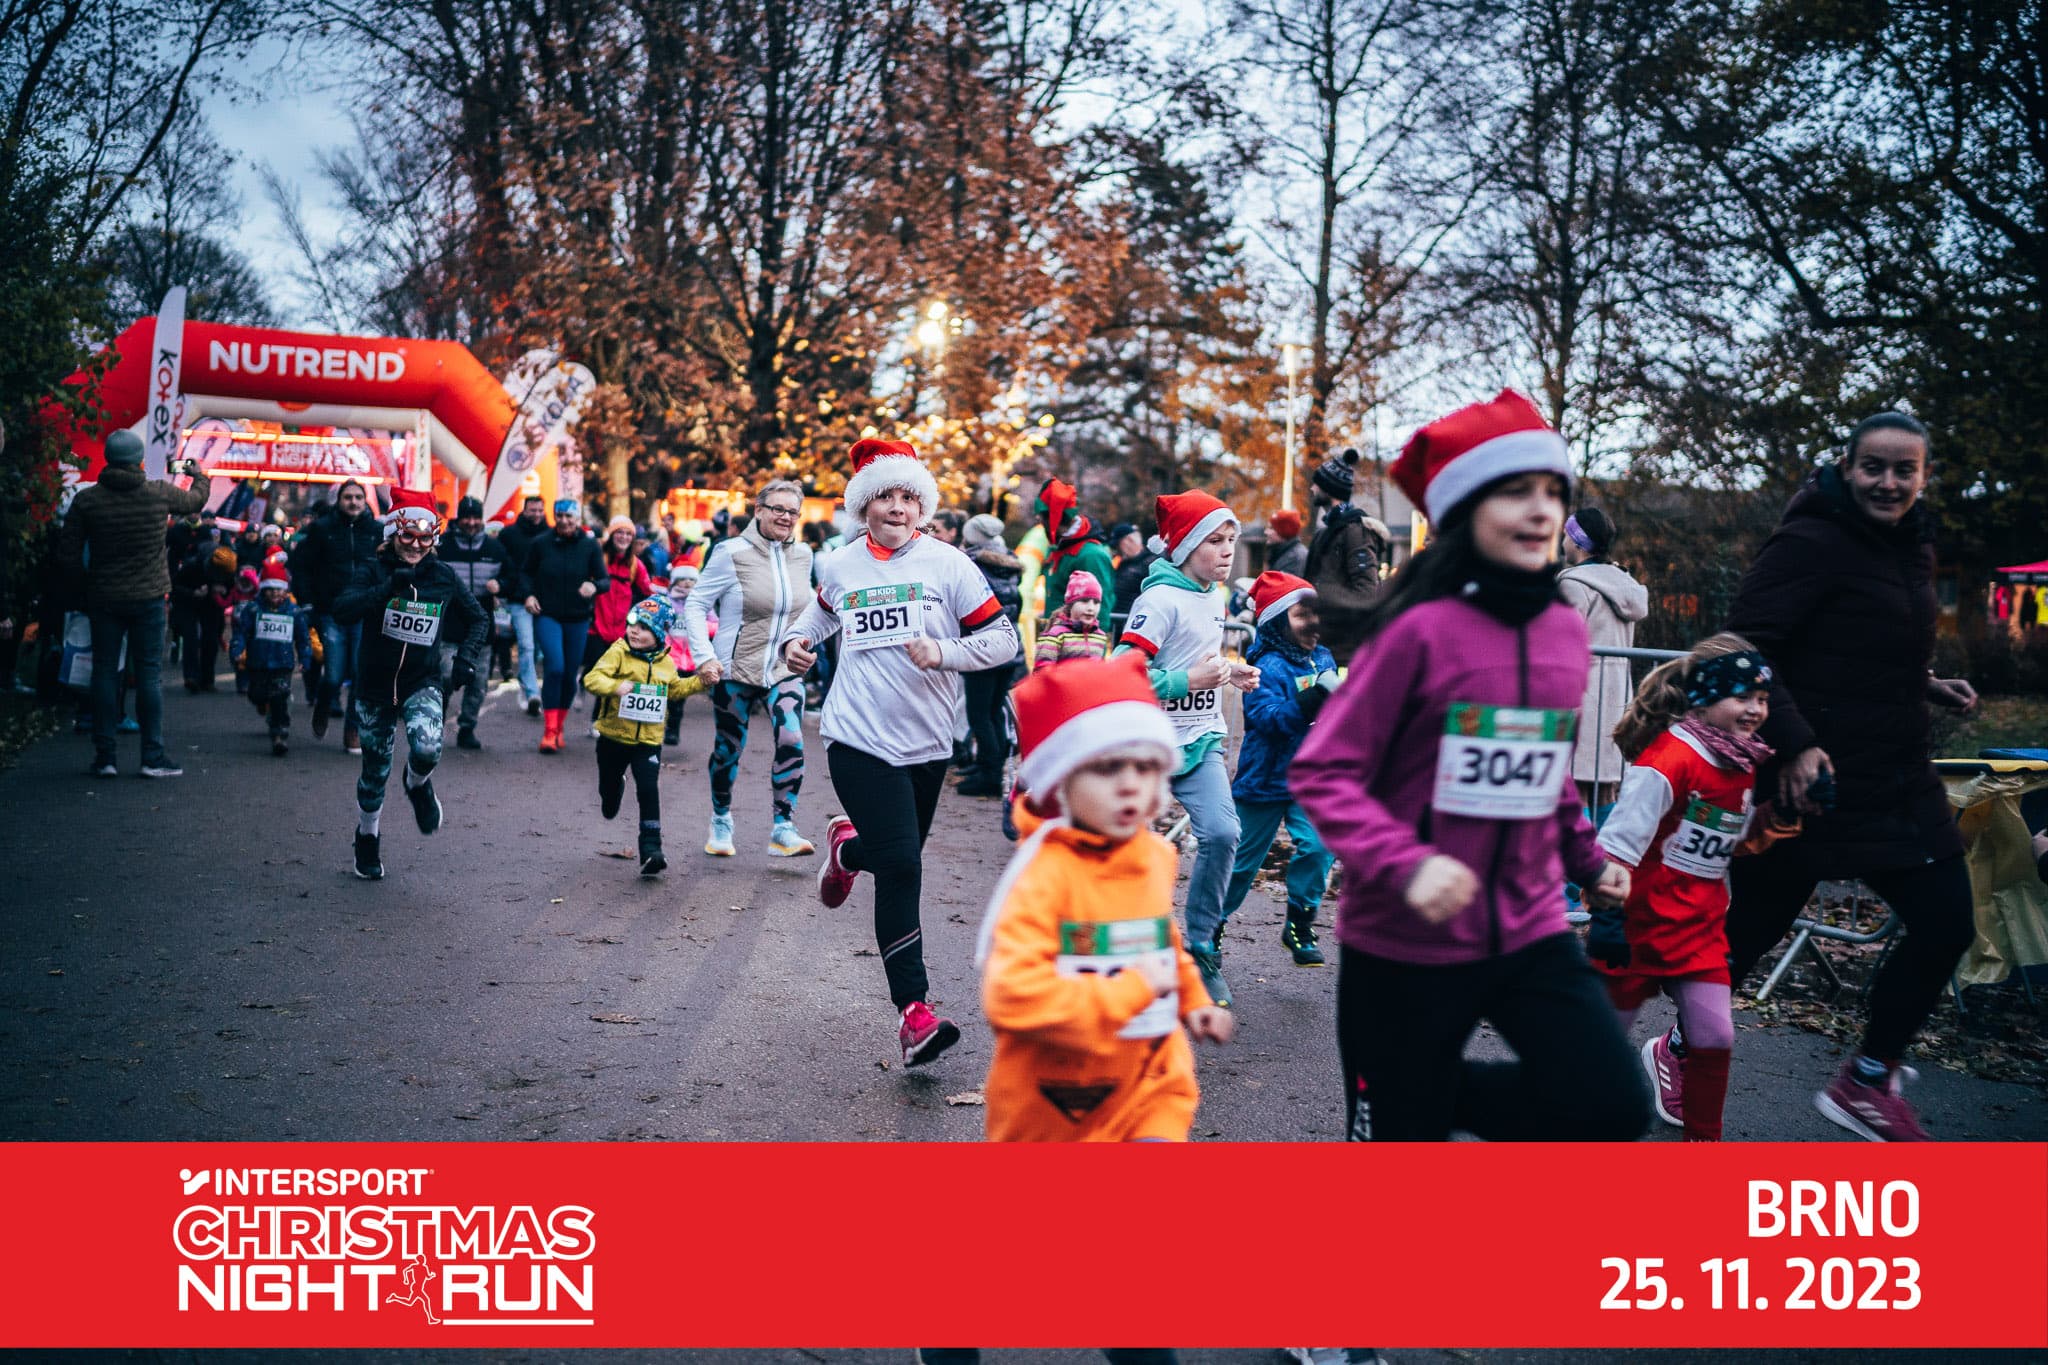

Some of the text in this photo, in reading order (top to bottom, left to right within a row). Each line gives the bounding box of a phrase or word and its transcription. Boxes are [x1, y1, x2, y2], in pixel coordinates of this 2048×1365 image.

[209, 340, 405, 382] NUTREND
[877, 587, 897, 595] KIDS
[262, 621, 288, 634] 3041
[390, 612, 433, 634] 3067
[854, 606, 909, 634] 3051
[626, 695, 662, 712] 3042
[1167, 690, 1216, 712] 3069
[1458, 747, 1556, 786] 3047
